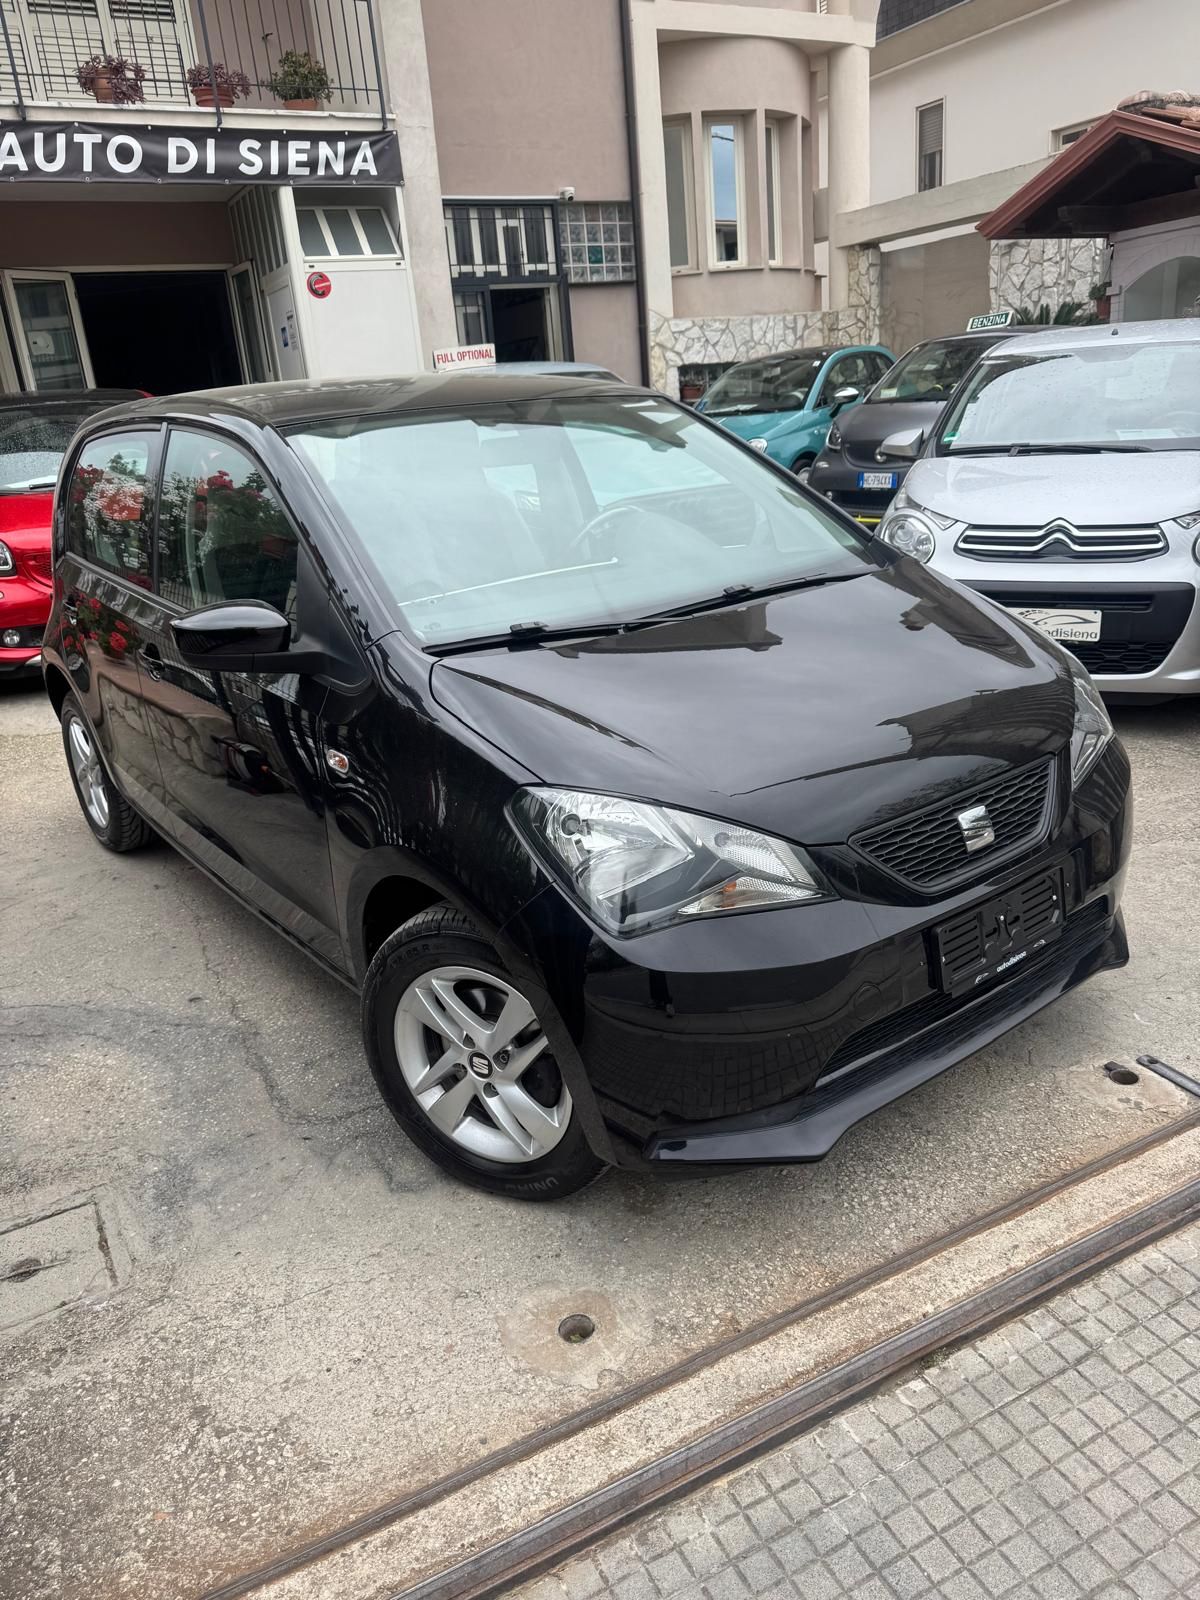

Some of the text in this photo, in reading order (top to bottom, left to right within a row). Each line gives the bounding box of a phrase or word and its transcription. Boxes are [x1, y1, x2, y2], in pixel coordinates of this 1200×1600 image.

[0, 131, 378, 175] AUTO DI SIENA
[972, 314, 1006, 328] BENZINA
[436, 348, 494, 364] FULL OPTIONAL
